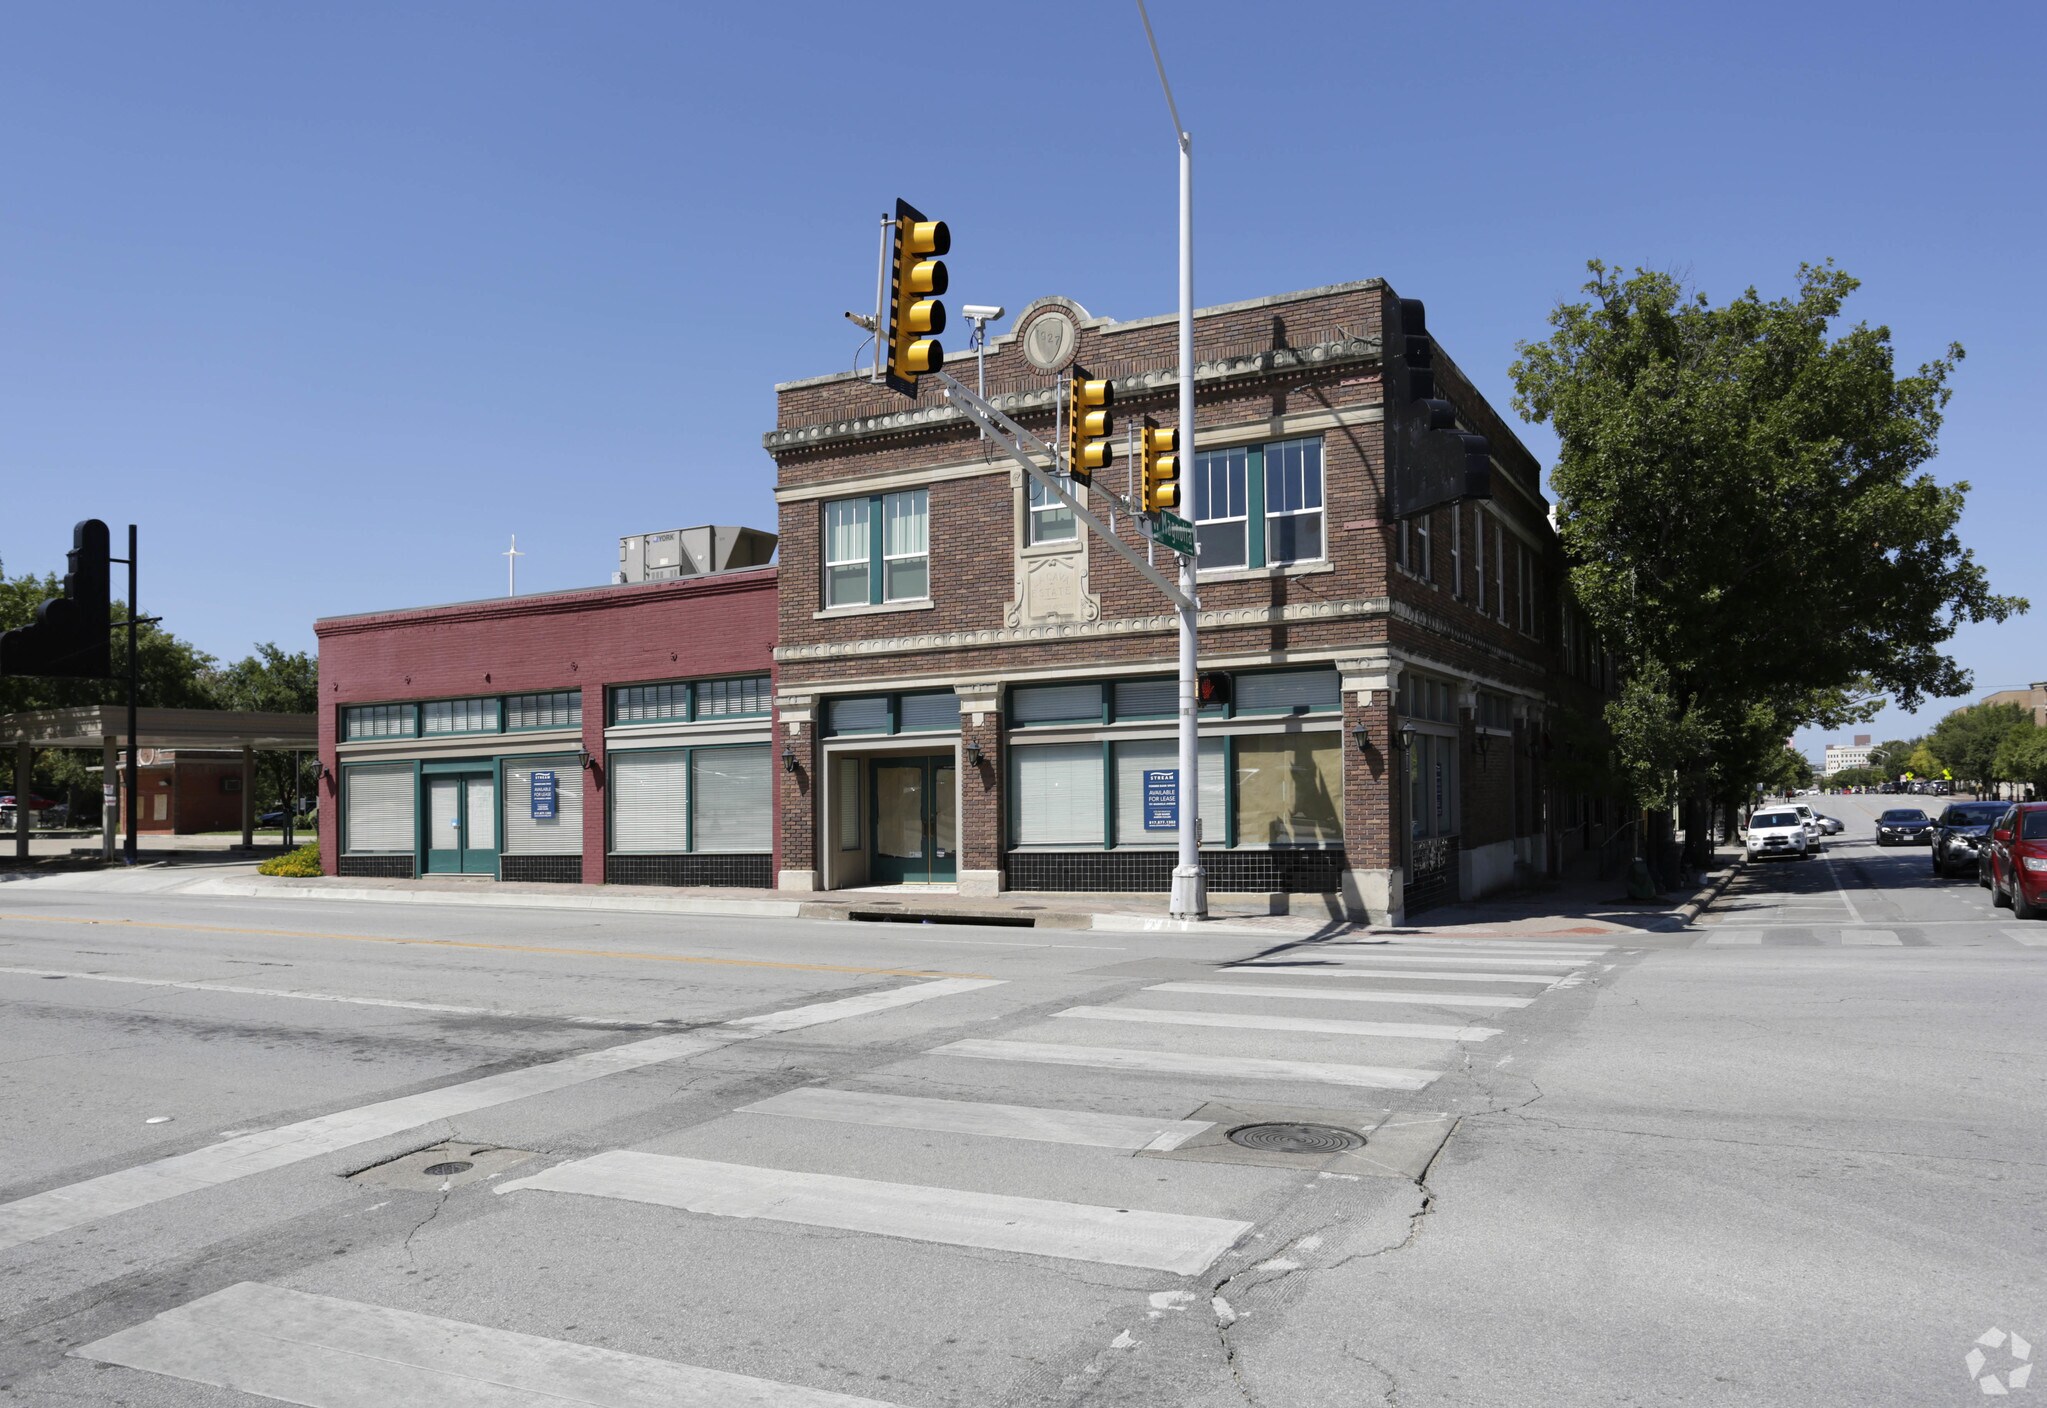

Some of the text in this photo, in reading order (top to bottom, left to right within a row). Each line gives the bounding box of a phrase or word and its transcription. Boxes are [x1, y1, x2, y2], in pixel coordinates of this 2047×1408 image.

[1036, 330, 1060, 346] 1927
[658, 533, 675, 542] YORK
[1031, 586, 1072, 599] ESTATE
